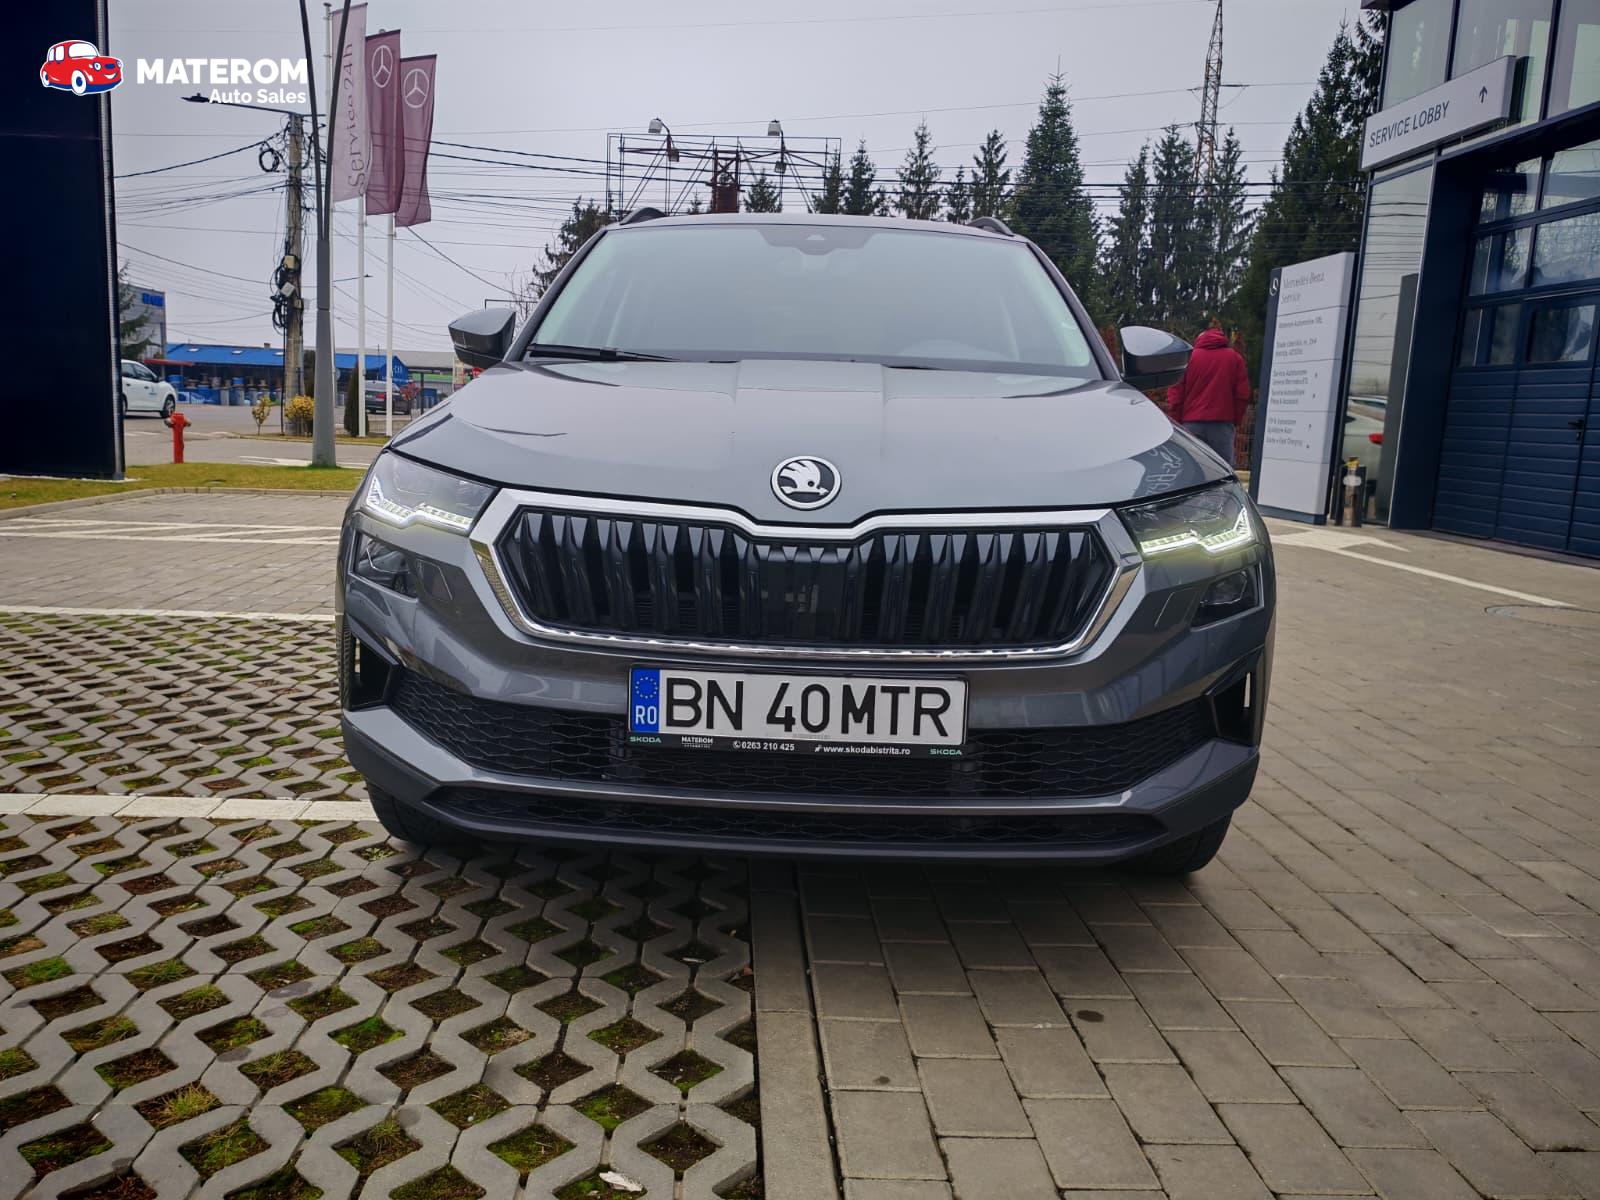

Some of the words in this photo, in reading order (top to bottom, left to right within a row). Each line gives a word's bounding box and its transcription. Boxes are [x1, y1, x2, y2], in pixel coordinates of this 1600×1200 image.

[1369, 117, 1411, 148] SERVICE
[1412, 100, 1450, 130] LOBBY
[634, 705, 658, 725] RO
[665, 677, 744, 731] BN
[766, 682, 831, 734] 40
[840, 684, 951, 737] MTR
[741, 741, 762, 750] 0263
[763, 741, 778, 750] 210
[779, 743, 795, 751] 425
[823, 745, 911, 755] www.skodabistrita.ro
